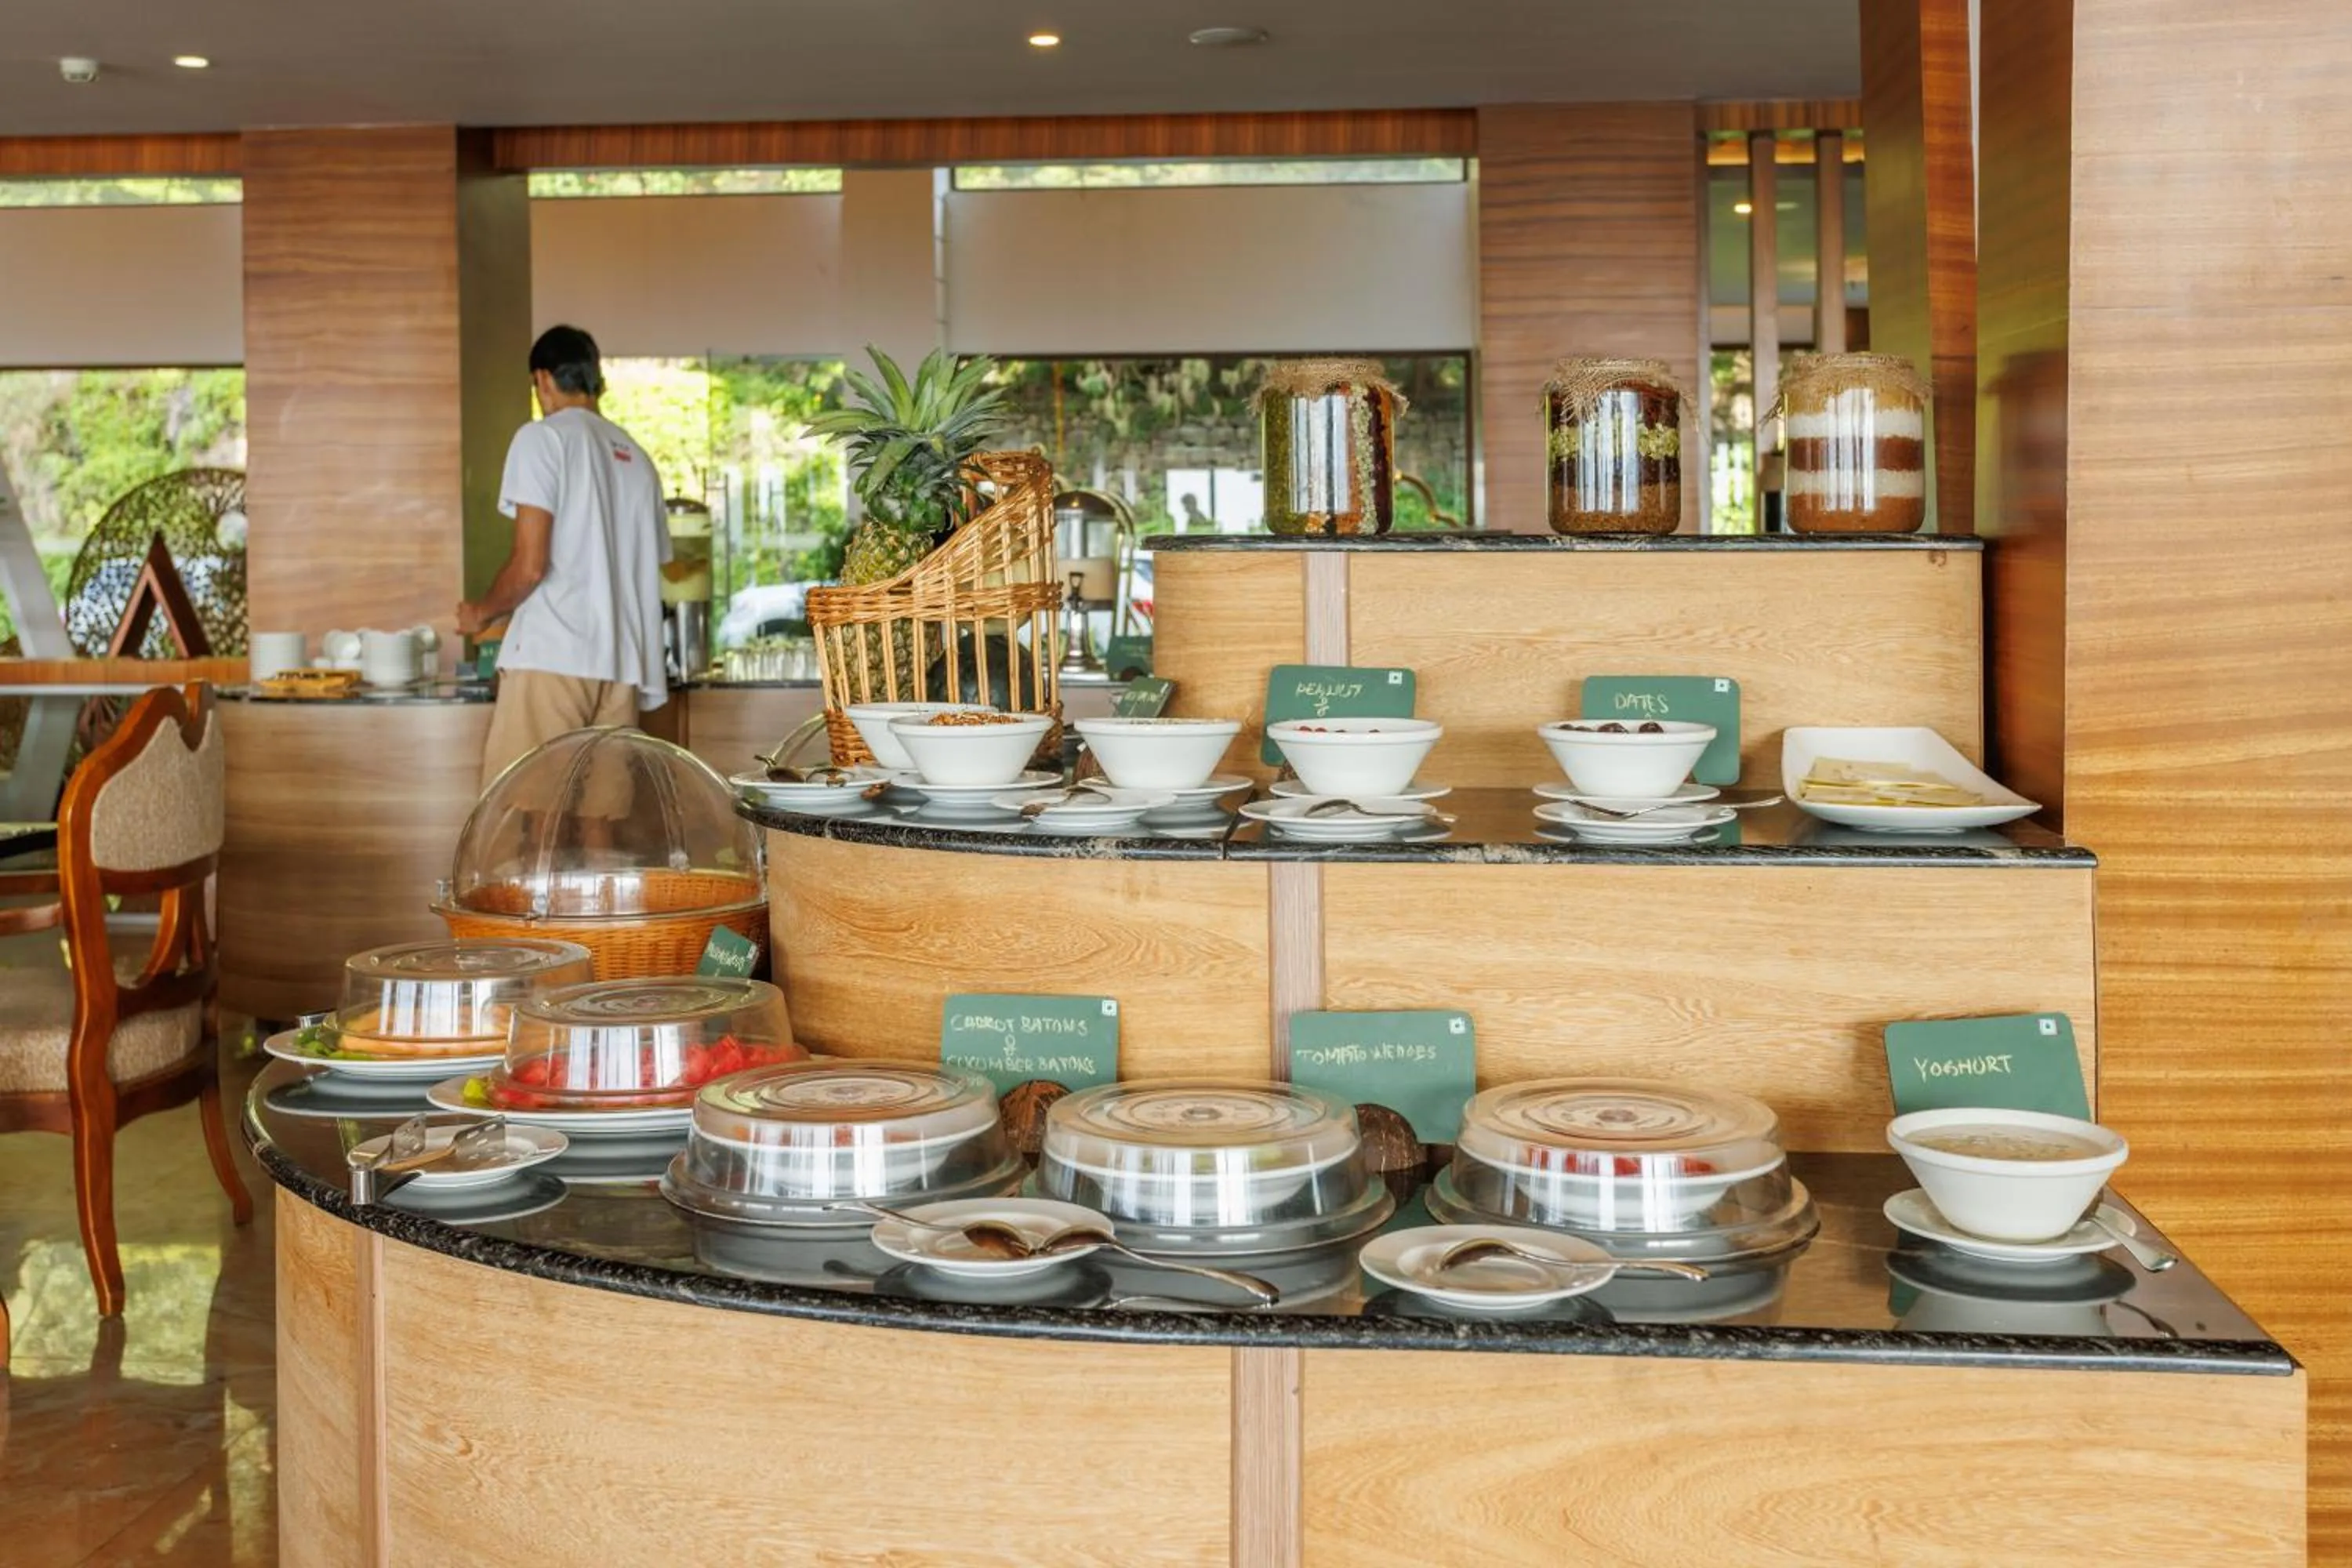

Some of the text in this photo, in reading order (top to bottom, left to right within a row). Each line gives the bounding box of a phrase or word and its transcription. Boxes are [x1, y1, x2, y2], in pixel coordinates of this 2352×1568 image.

[1613, 692, 1669, 713] DATES
[950, 1014, 1089, 1036] CARROT BATONS
[1295, 1044, 1367, 1065] TOMATO
[1038, 1056, 1096, 1075] BATONS
[1914, 1054, 2013, 1083] YOGHURT
